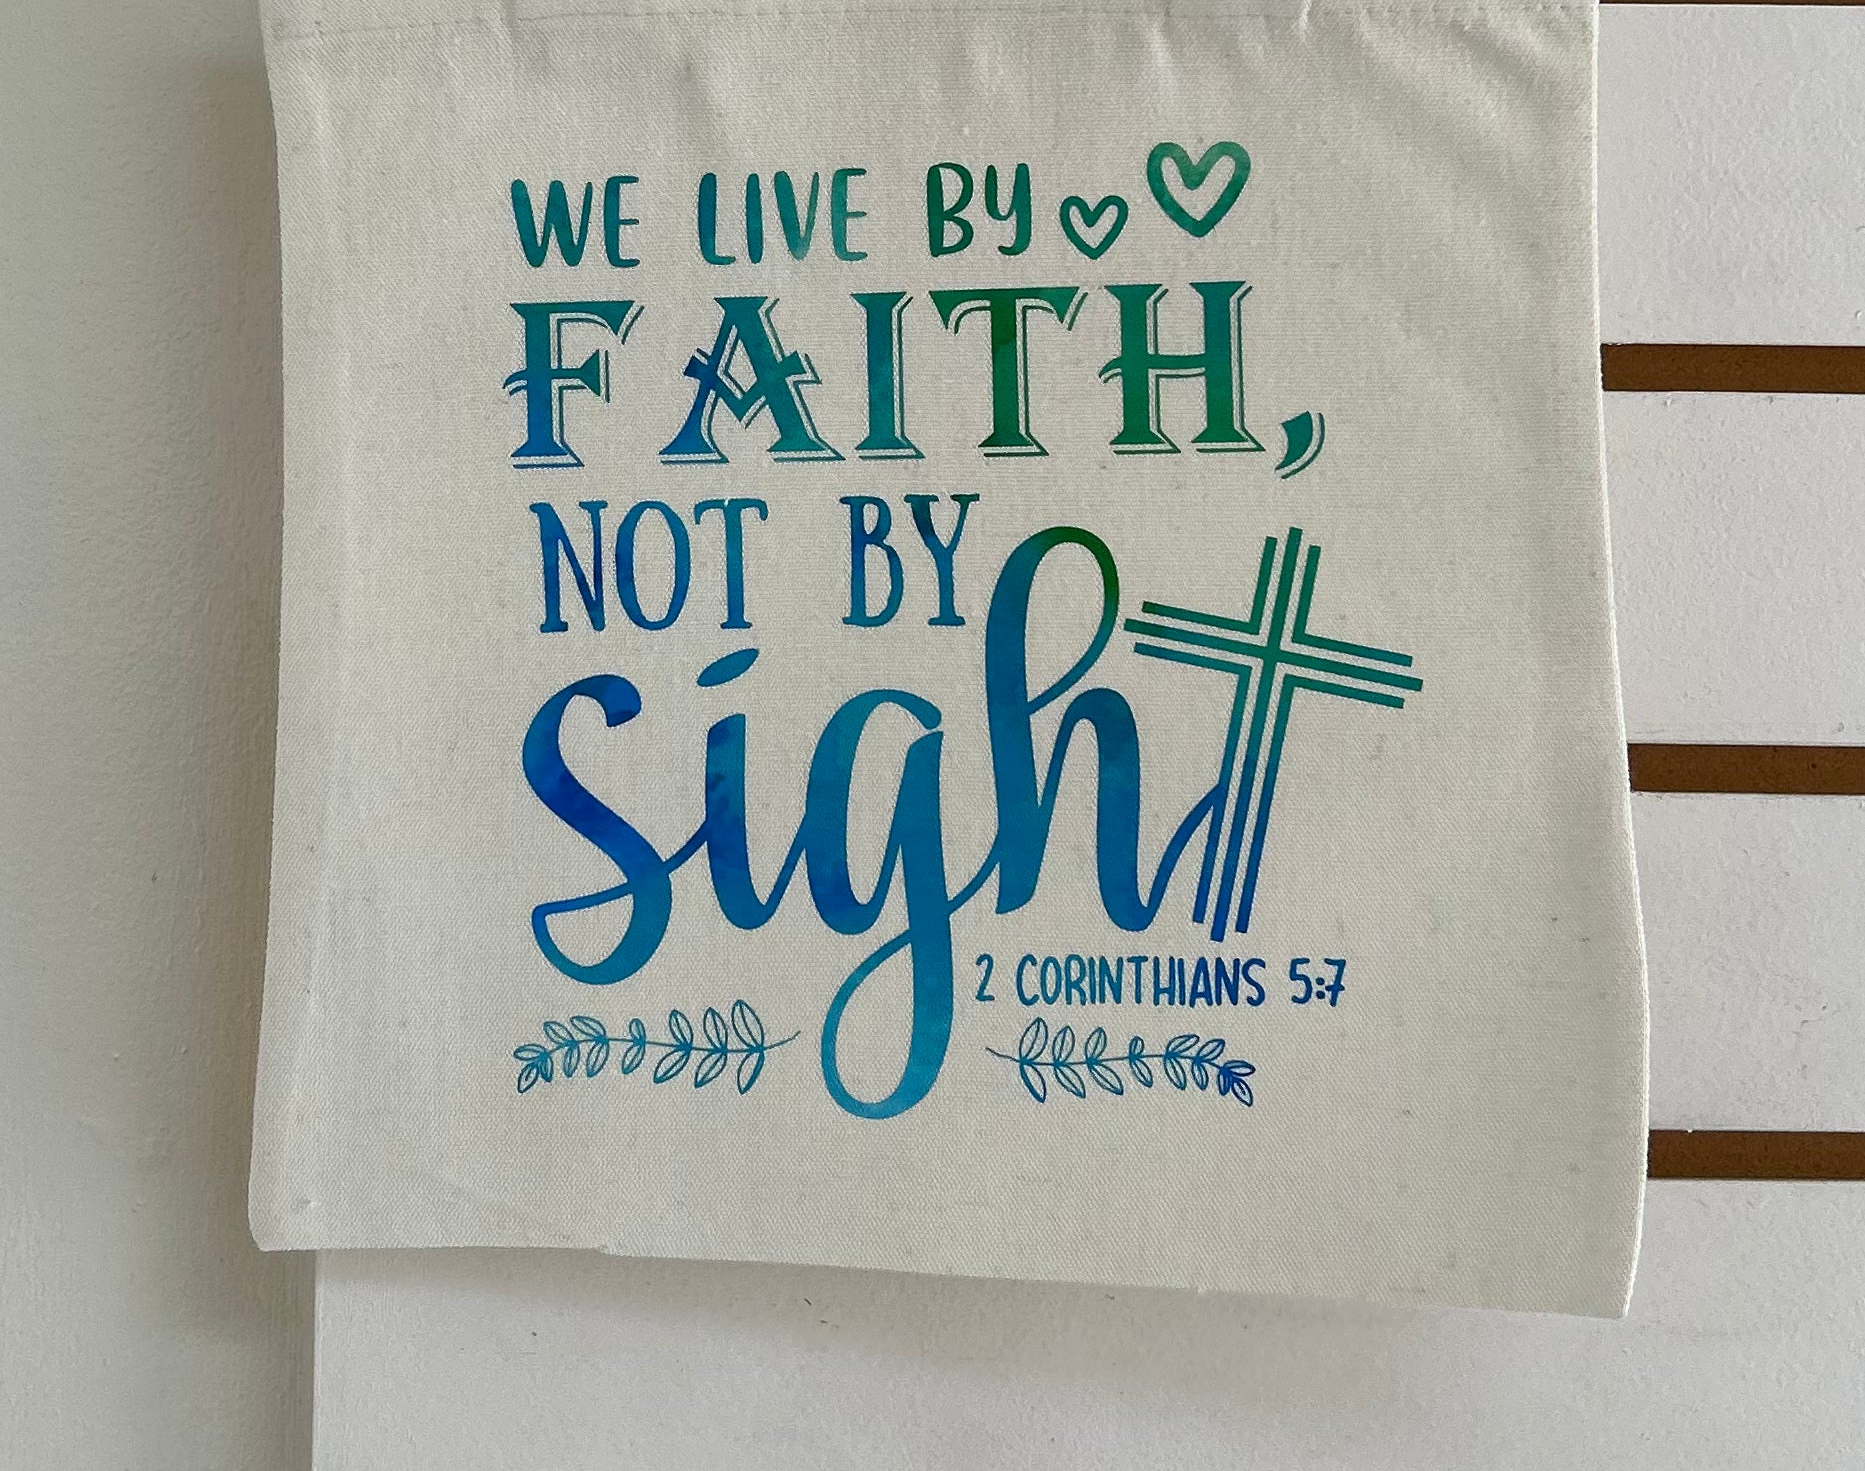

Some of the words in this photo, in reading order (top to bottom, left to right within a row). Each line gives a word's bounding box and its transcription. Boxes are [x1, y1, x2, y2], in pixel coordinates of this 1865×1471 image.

[510, 175, 640, 269] WE
[697, 167, 868, 266] LIVE
[926, 162, 1032, 258] BY
[503, 280, 1325, 479] FAITH,
[529, 498, 768, 634] NOT
[840, 494, 981, 628] BY
[522, 526, 1424, 1120] sight
[975, 953, 995, 1003] 2
[1015, 954, 1266, 1008] CORINTHIANS
[1288, 957, 1347, 1008] 5:7
